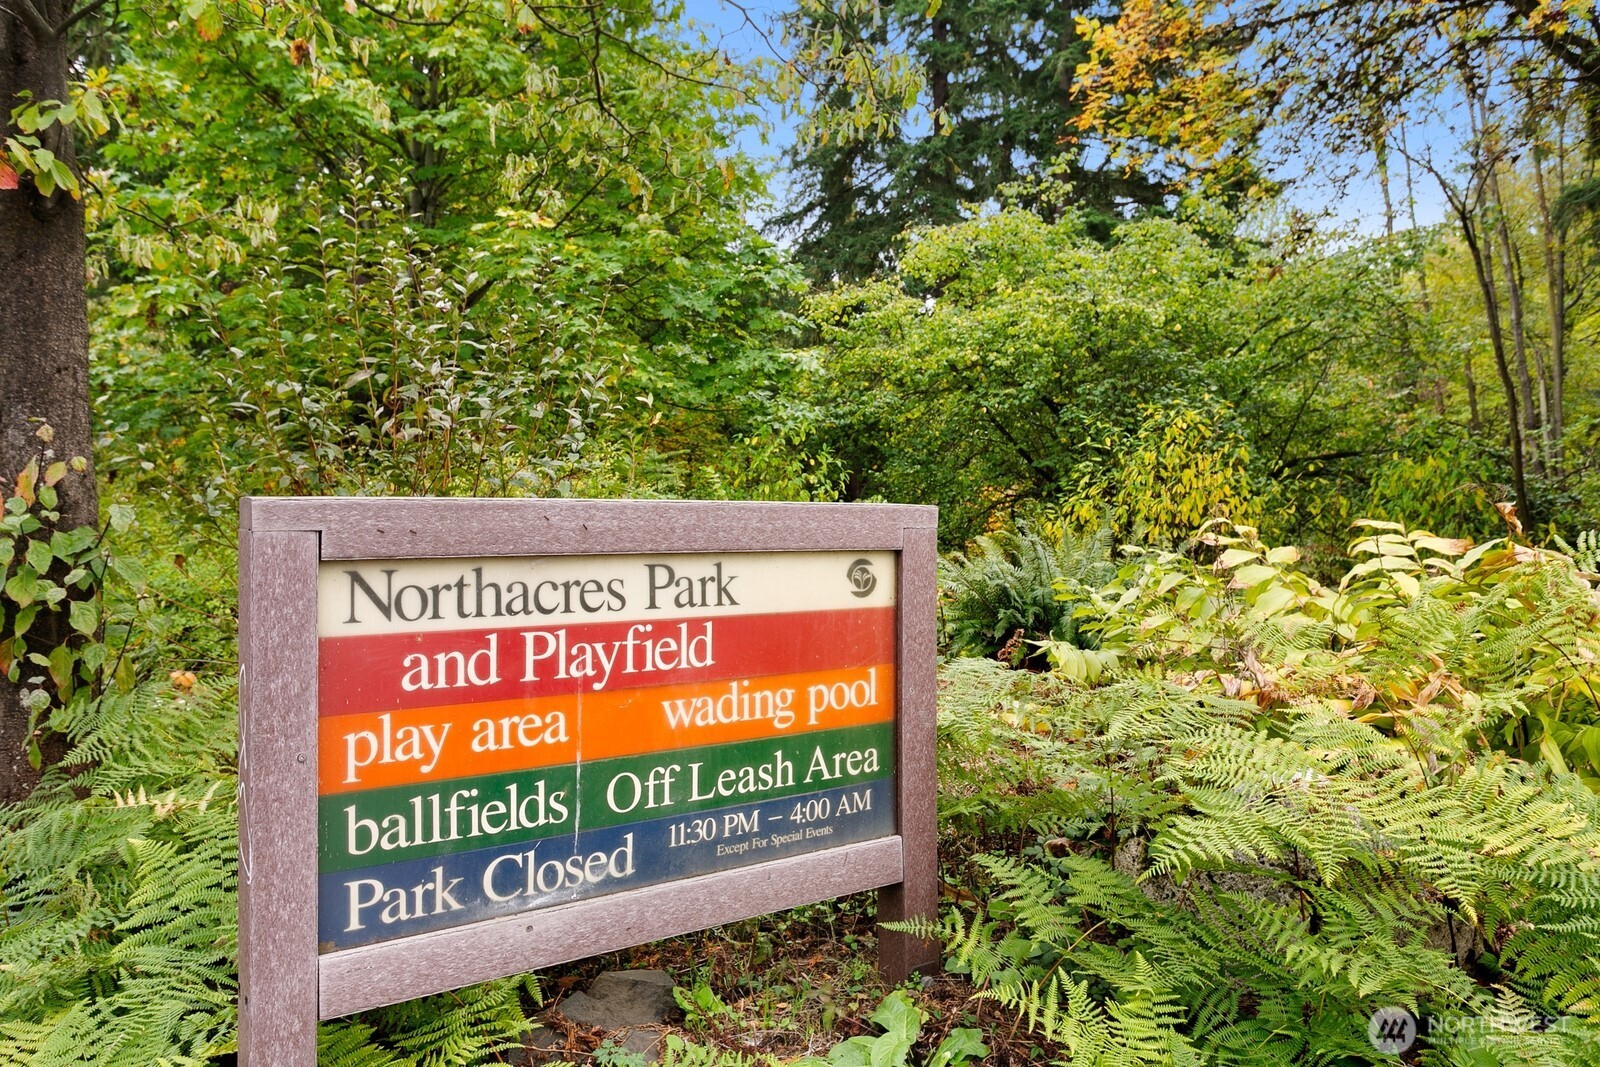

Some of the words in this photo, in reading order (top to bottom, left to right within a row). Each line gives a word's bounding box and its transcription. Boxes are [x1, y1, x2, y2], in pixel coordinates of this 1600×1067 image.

[342, 566, 626, 624] Northacres
[644, 561, 740, 610] Park
[401, 633, 502, 691] and
[520, 620, 716, 690] Playfield
[661, 680, 796, 729] wading
[807, 667, 879, 725] pool
[342, 713, 452, 784] play
[471, 711, 569, 754] area
[606, 764, 681, 814] Off
[687, 750, 795, 802] Leash
[803, 745, 880, 783] Area
[343, 779, 569, 856] ballfields
[668, 817, 717, 848] 11:30
[722, 809, 760, 838] PM
[789, 797, 830, 824] 4:00
[835, 788, 872, 817] AM
[716, 841, 750, 856] Except
[752, 837, 769, 849] For
[771, 829, 803, 848] Special
[805, 825, 834, 839] Events
[343, 866, 465, 932] Park
[483, 832, 635, 902] Closed
